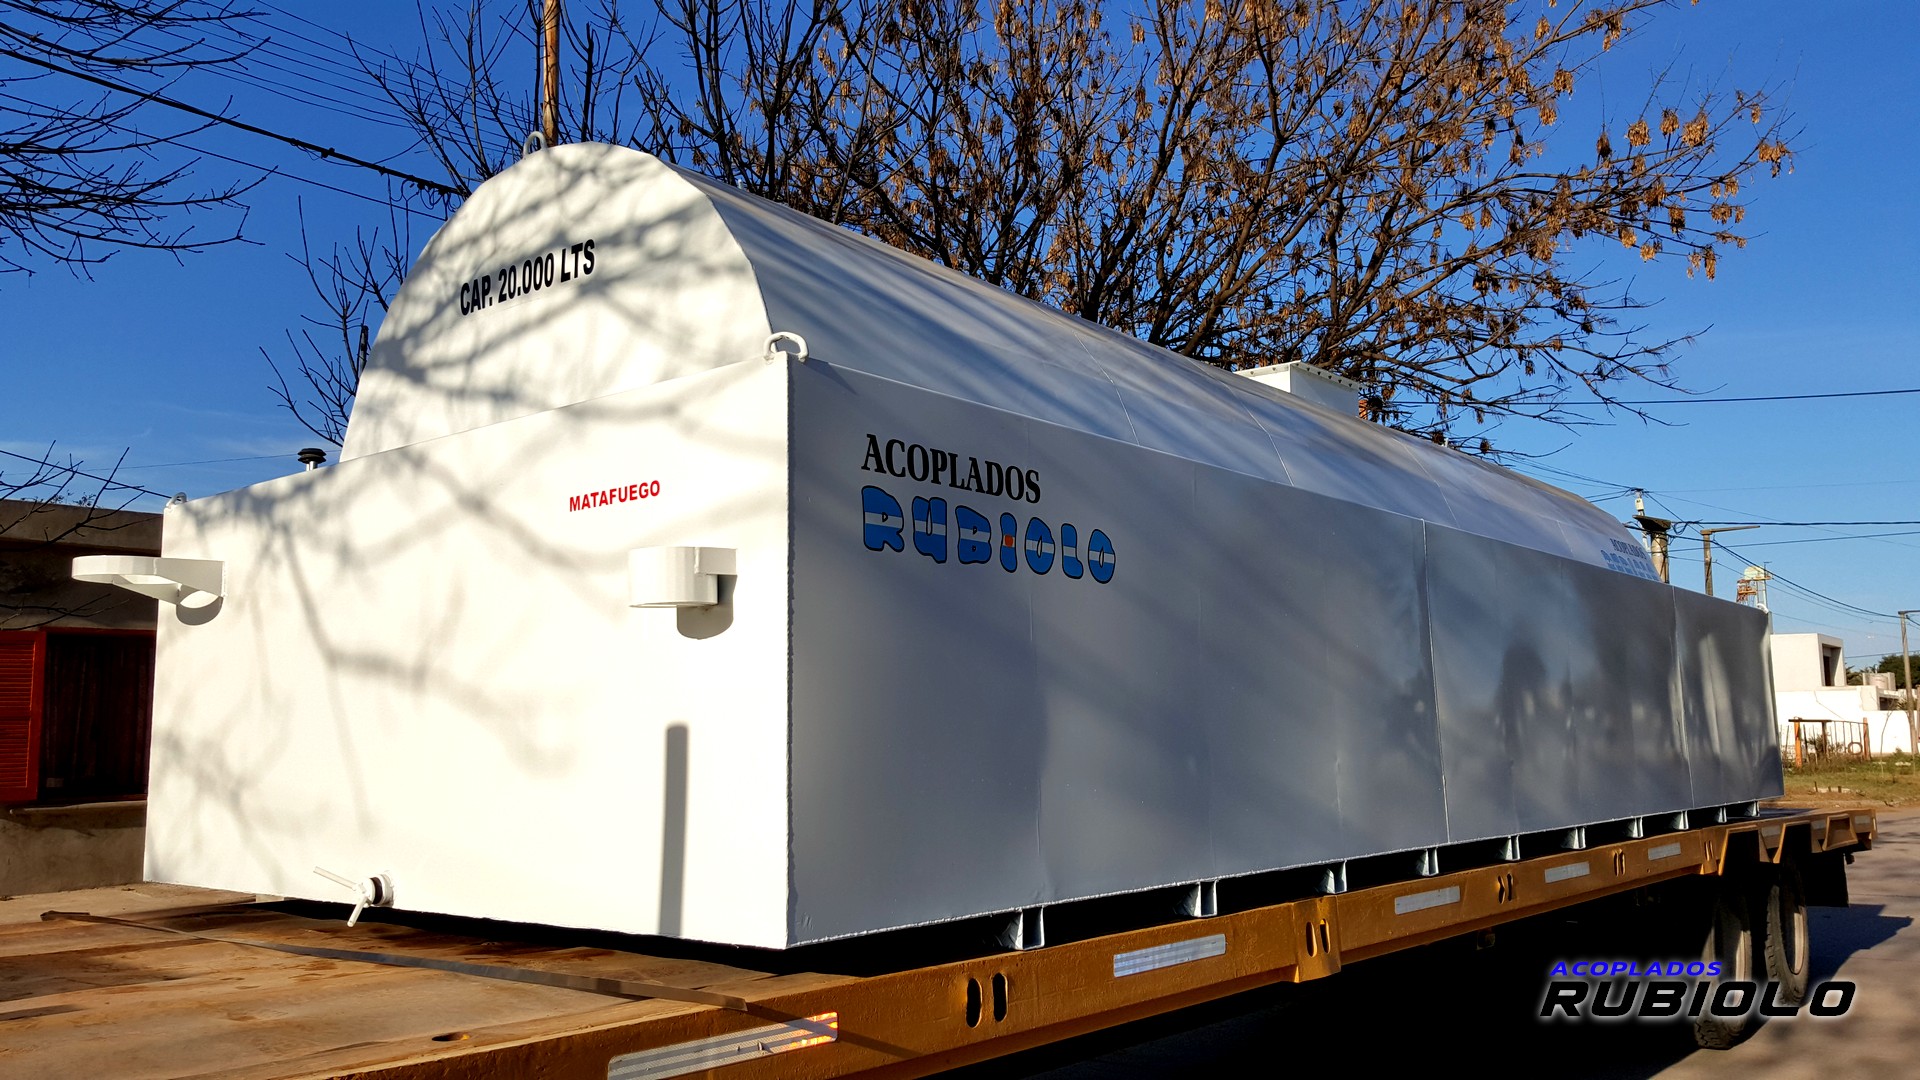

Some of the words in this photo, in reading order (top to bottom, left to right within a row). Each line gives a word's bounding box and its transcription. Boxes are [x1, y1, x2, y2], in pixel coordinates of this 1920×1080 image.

[460, 275, 493, 315] CAP.
[498, 253, 554, 303] 20.000
[561, 239, 595, 282] LTS
[569, 480, 661, 512] MATAFUEGO
[861, 433, 1041, 504] ACOPLADOS
[861, 485, 1116, 584] RUBIOLO
